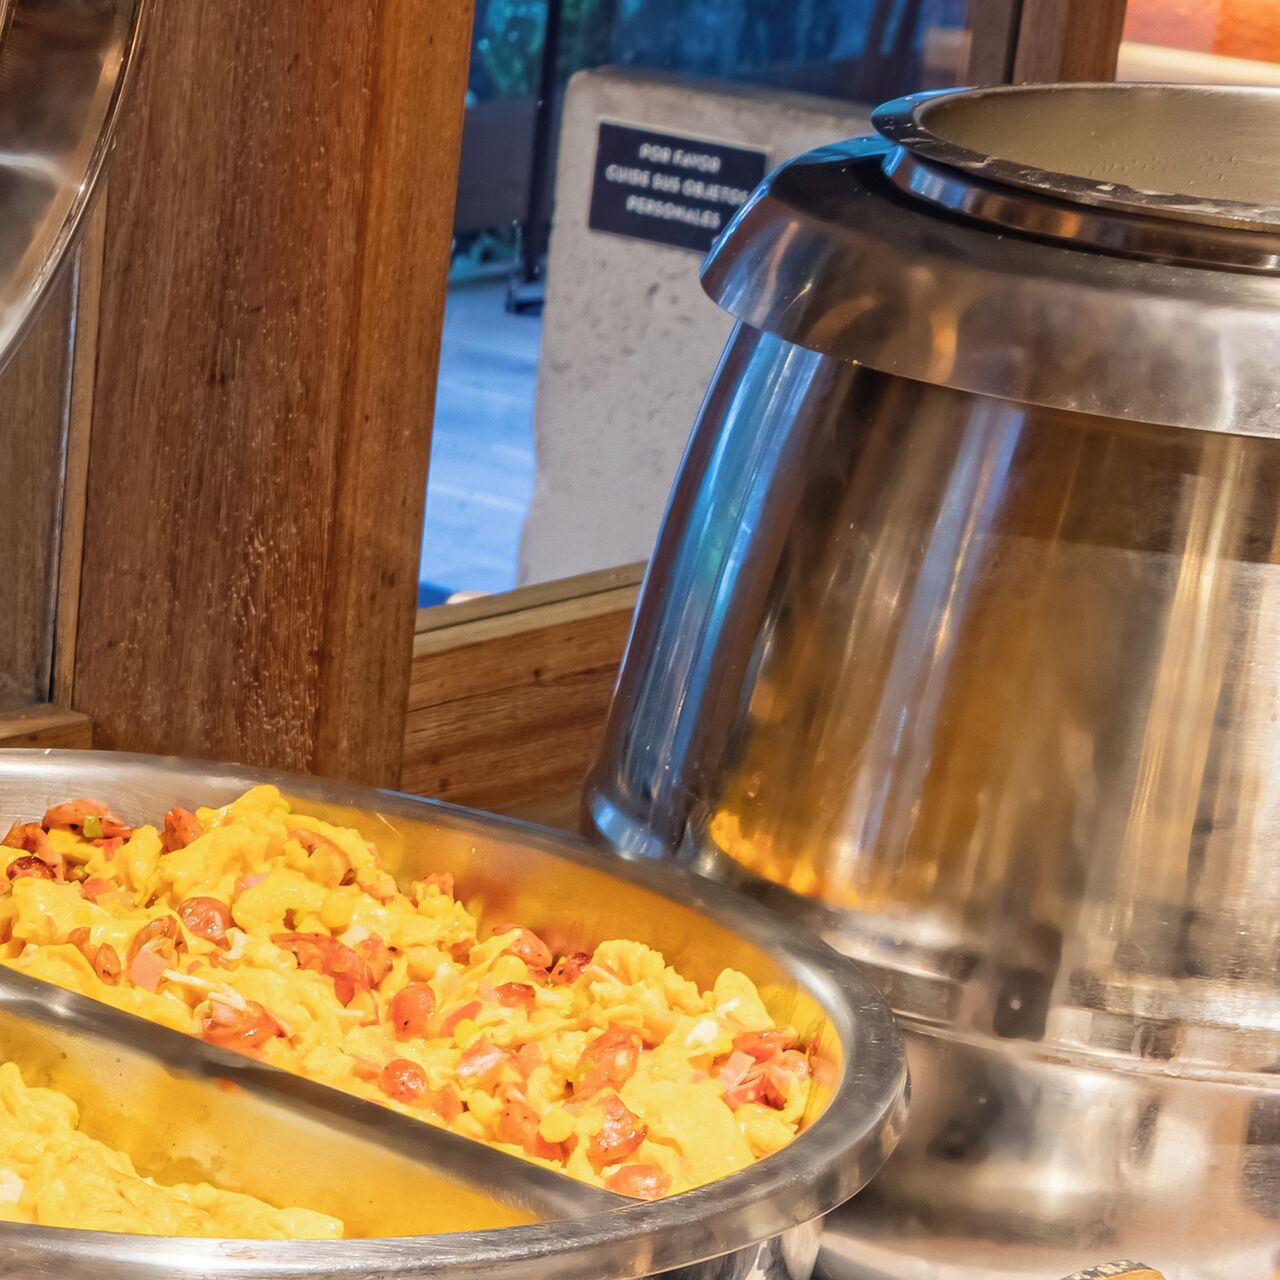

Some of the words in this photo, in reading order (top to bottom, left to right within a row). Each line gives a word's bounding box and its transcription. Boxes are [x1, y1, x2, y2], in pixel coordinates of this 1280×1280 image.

[638, 142, 671, 164] POR
[672, 149, 721, 174] FAVOR
[605, 163, 650, 188] CUIDE
[651, 172, 680, 194] SUS
[626, 195, 720, 229] PERSONALES
